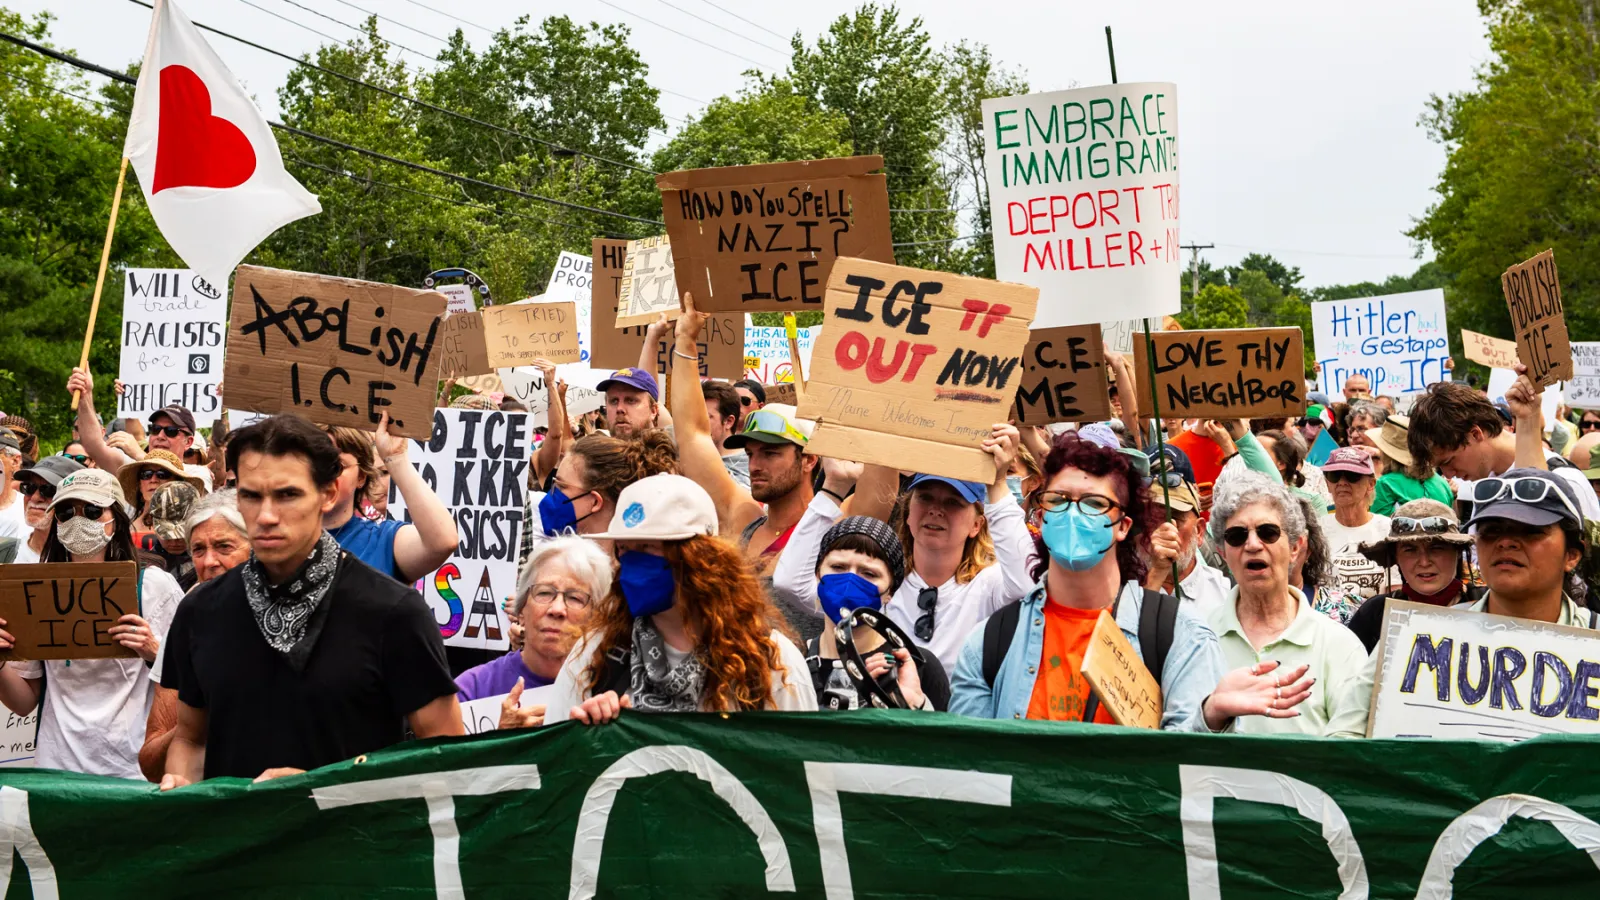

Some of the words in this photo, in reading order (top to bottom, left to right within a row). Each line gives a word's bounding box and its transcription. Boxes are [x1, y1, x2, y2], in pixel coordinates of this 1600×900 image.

[994, 93, 1168, 150] EMBRACE
[679, 189, 724, 221] HOW
[787, 186, 850, 218] SPELL
[1007, 187, 1145, 236] DEPORT
[1153, 183, 1180, 221] TRU
[717, 218, 849, 257] NAZI?
[1023, 230, 1146, 273] MILLER
[560, 256, 593, 274] DUE
[129, 272, 181, 298] WILL
[1506, 256, 1562, 335] ABOLISH
[138, 296, 208, 313] trade
[444, 315, 478, 332] LISH
[519, 307, 567, 324] TRIED
[834, 274, 943, 335] ICE
[958, 298, 1012, 339] TF
[1331, 300, 1416, 338] Hitler
[1417, 312, 1439, 330] had
[125, 321, 222, 348] RACISTS
[443, 334, 464, 355] CE
[501, 335, 520, 348] TO
[744, 340, 771, 348] WHEN
[745, 328, 770, 338] THIS
[797, 329, 810, 339] ND
[1332, 340, 1356, 352] the
[1361, 335, 1447, 361] Gestapo
[1473, 334, 1495, 347] ICE
[136, 352, 176, 372] for
[834, 330, 938, 384] OUT
[935, 347, 1020, 390] NOW
[1150, 336, 1227, 375] LOVE
[1236, 337, 1291, 372] THY
[1482, 346, 1508, 361] OUT
[121, 382, 218, 413] REFUGEES
[291, 362, 404, 428] I.C.E.
[826, 386, 870, 421] Maine
[882, 400, 936, 429] Welcomes
[1166, 370, 1300, 411] NEIGHBOR
[411, 410, 448, 453] O
[456, 411, 528, 460] ICE
[452, 459, 529, 507] KKK
[1333, 559, 1370, 567] #RESIST
[22, 577, 128, 617] FUCK
[414, 562, 503, 641] SA
[36, 619, 116, 649] ICE
[1103, 634, 1138, 683] MAINE
[1399, 633, 1600, 722] MURDE
[1114, 675, 1145, 721] LAND
